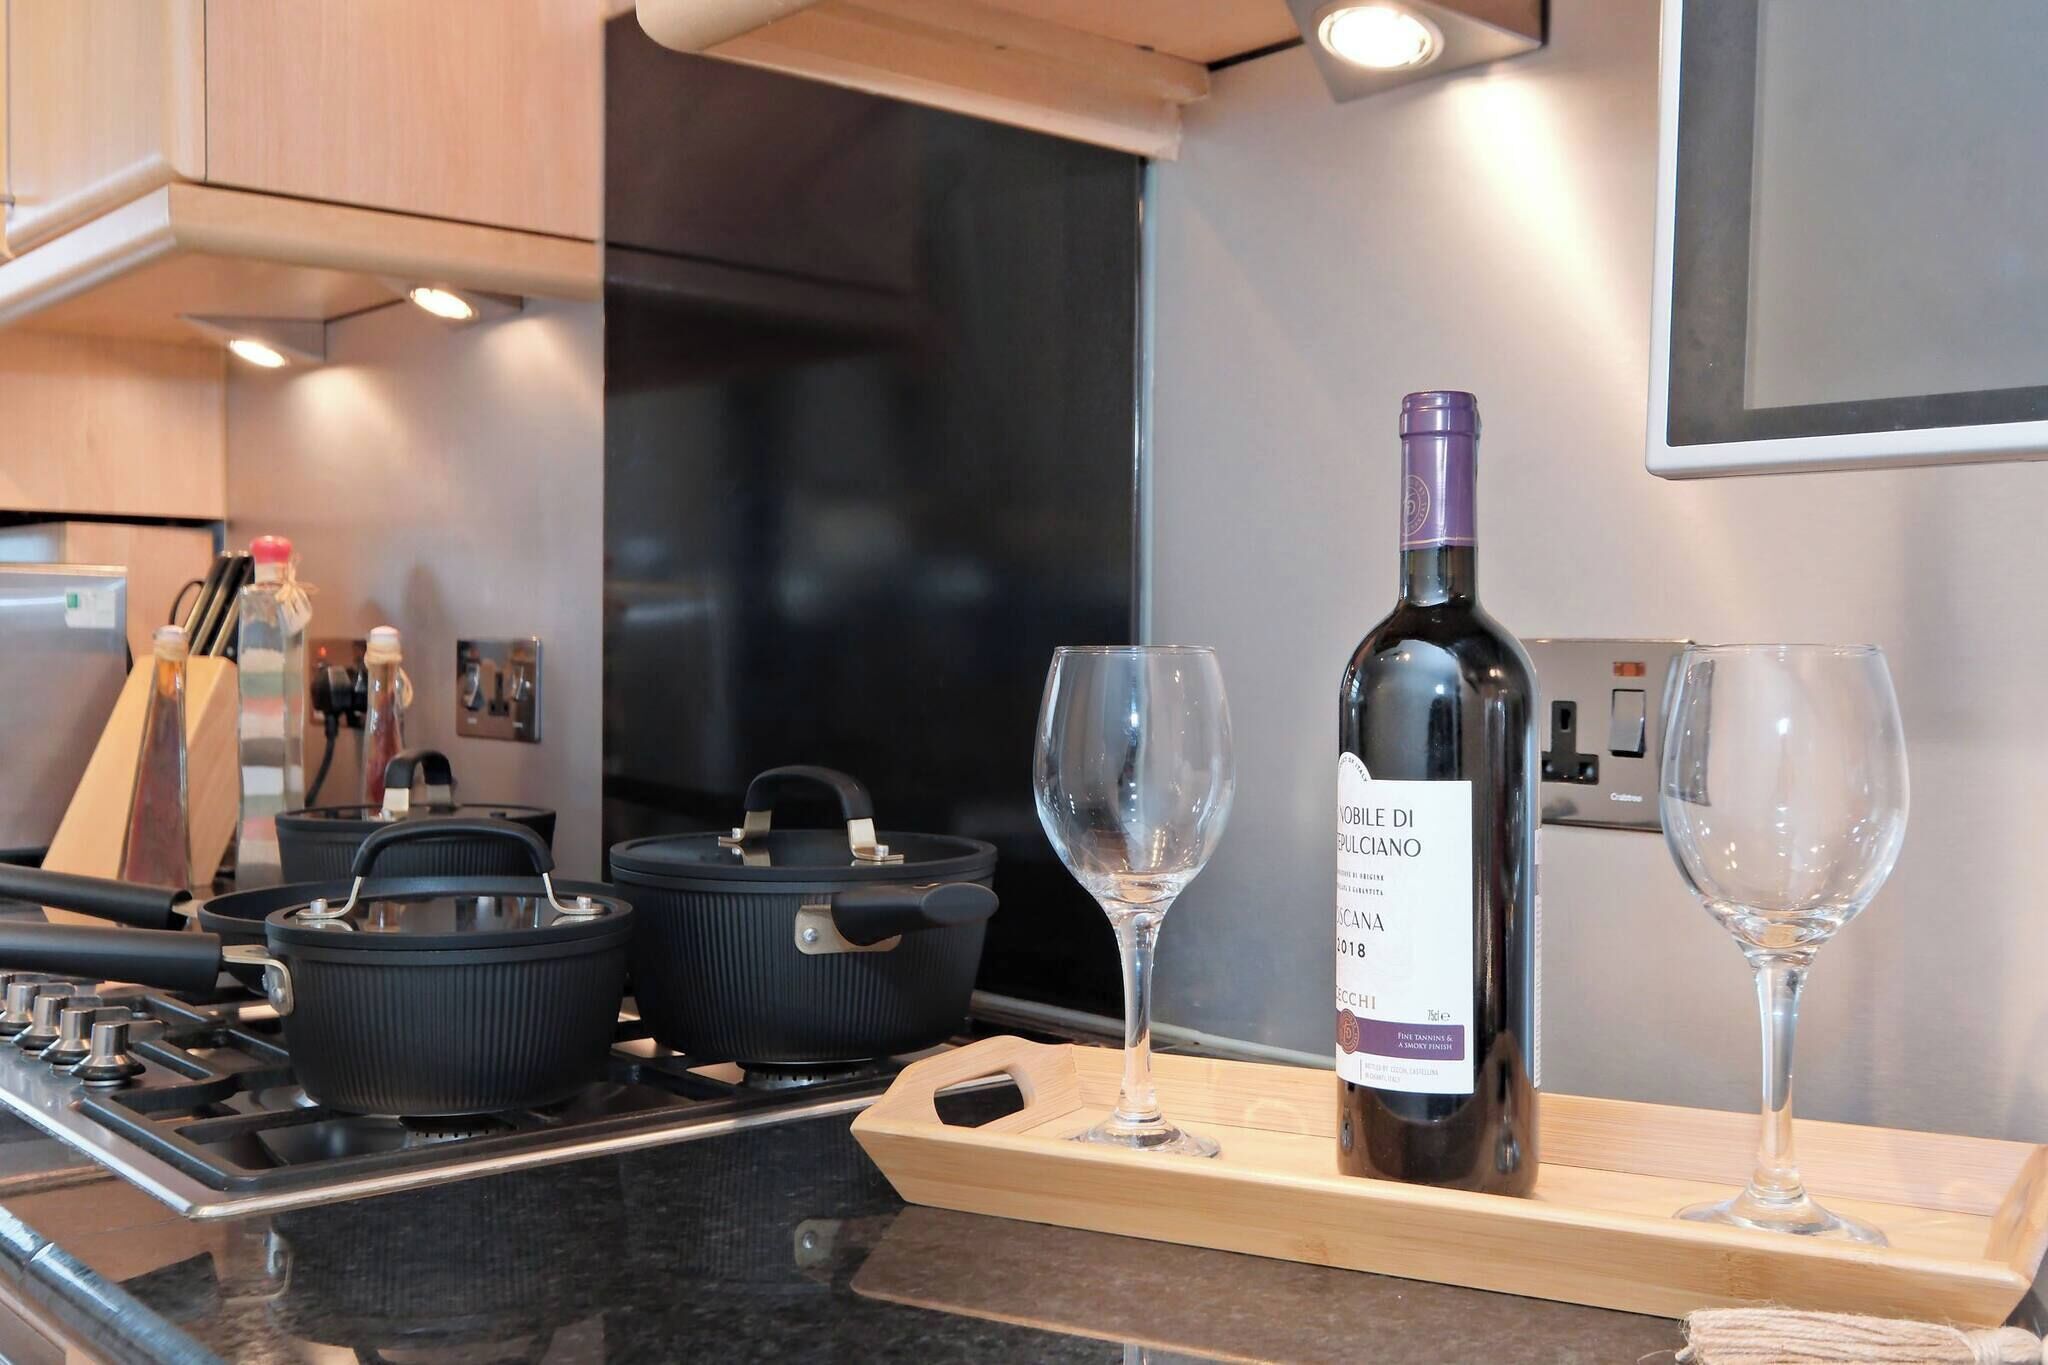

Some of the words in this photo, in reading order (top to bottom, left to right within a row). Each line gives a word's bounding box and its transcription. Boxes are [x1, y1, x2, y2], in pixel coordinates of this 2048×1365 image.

[1393, 809, 1413, 828] DI
[1337, 937, 1366, 958] 2018
[1427, 1009, 1440, 1023] 75cl
[1397, 1031, 1412, 1040] FINE
[1414, 1033, 1445, 1042] TANNINS
[1446, 1034, 1454, 1042] &
[1404, 1042, 1427, 1050] SMOKY
[1428, 1043, 1453, 1051] FINISH
